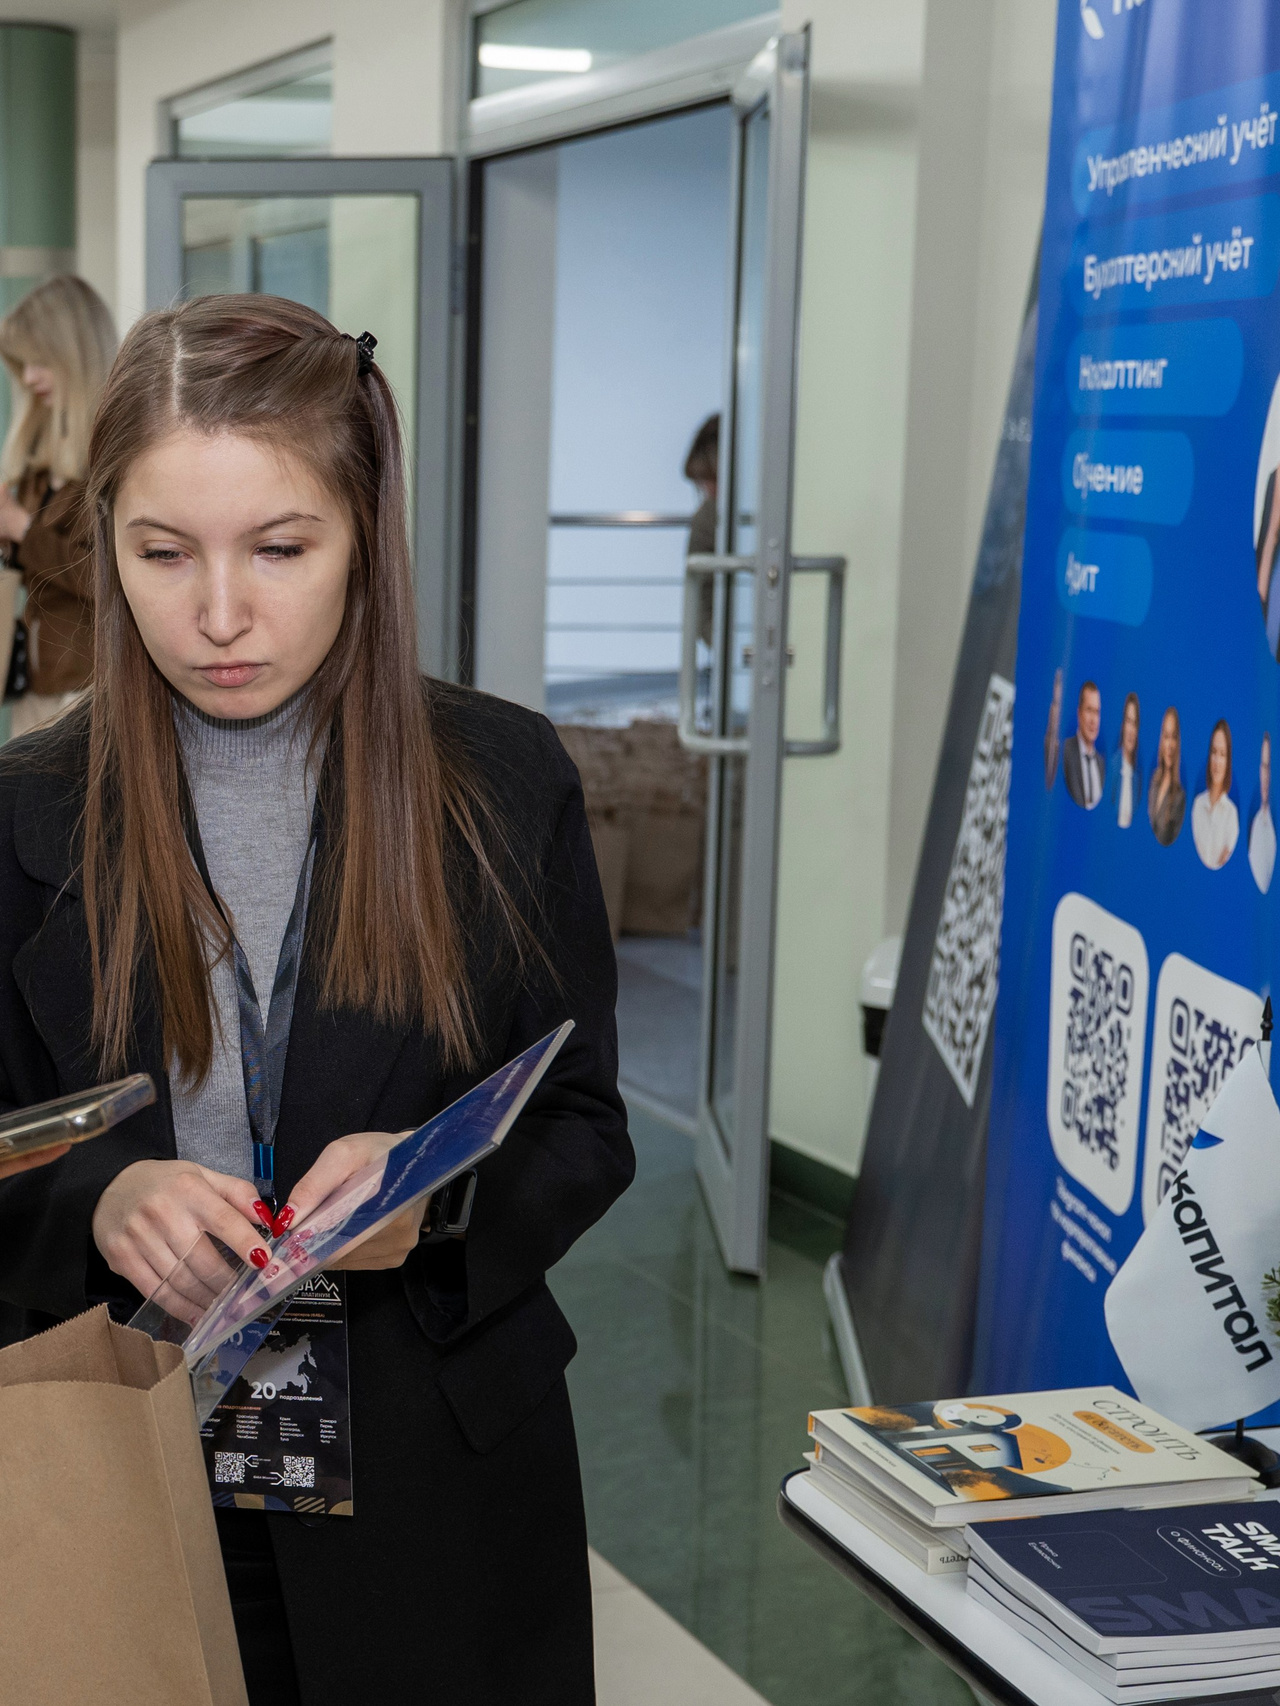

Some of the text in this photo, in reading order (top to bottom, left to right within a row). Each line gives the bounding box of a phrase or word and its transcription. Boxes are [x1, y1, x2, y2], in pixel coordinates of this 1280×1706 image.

[1087, 102, 1278, 196] Упрленческий учёт
[1083, 226, 1254, 300] Буалтерский учёт
[1078, 354, 1168, 391] Ксалтинг
[1072, 452, 1144, 500] Очение
[1064, 551, 1100, 596] Адит
[1170, 1169, 1274, 1373] капитал
[251, 1381, 277, 1400] 20
[1092, 1399, 1202, 1461] СТРОИТЬ
[939, 1554, 969, 1564] атеть
[1176, 1537, 1228, 1572] финансах
[1201, 1522, 1280, 1571] TALK
[1233, 1521, 1280, 1558] SM
